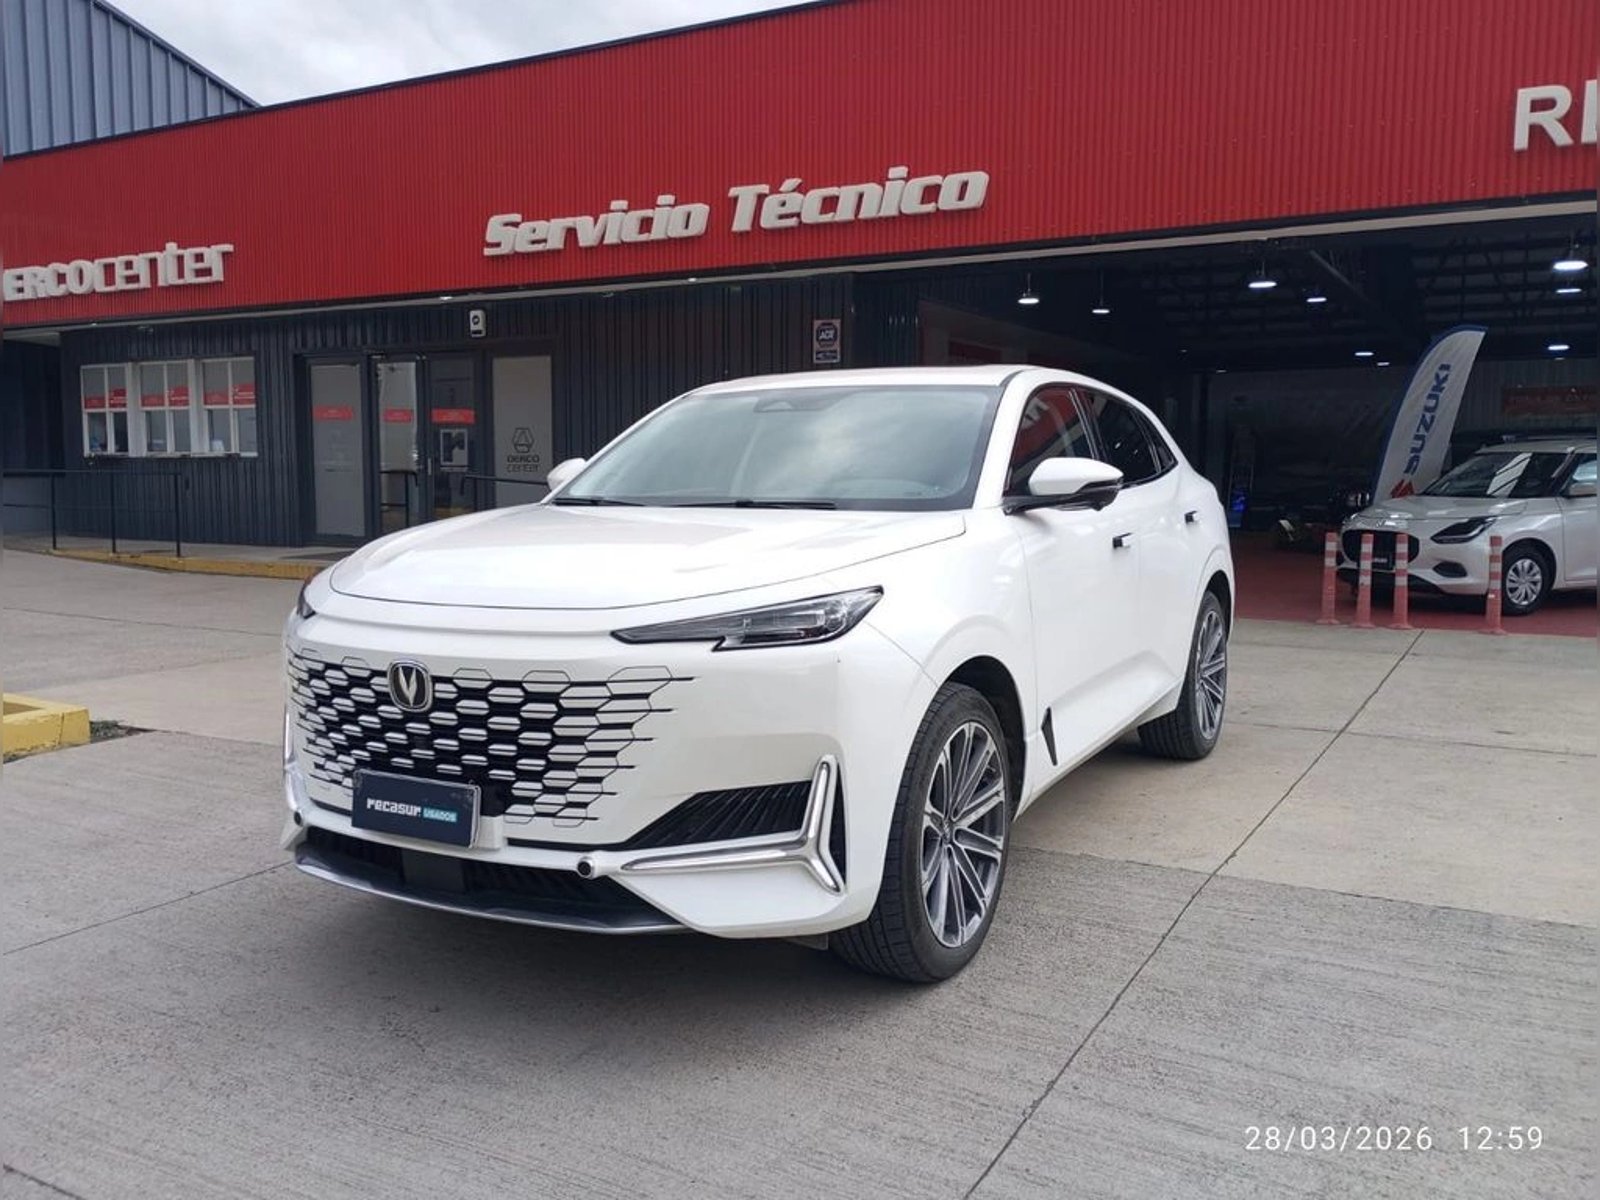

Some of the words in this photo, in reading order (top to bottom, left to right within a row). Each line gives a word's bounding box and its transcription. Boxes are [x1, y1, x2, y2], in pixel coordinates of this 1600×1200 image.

[483, 194, 710, 257] Servicio
[727, 165, 991, 232] Técnico
[1403, 363, 1451, 476] SUZUKI
